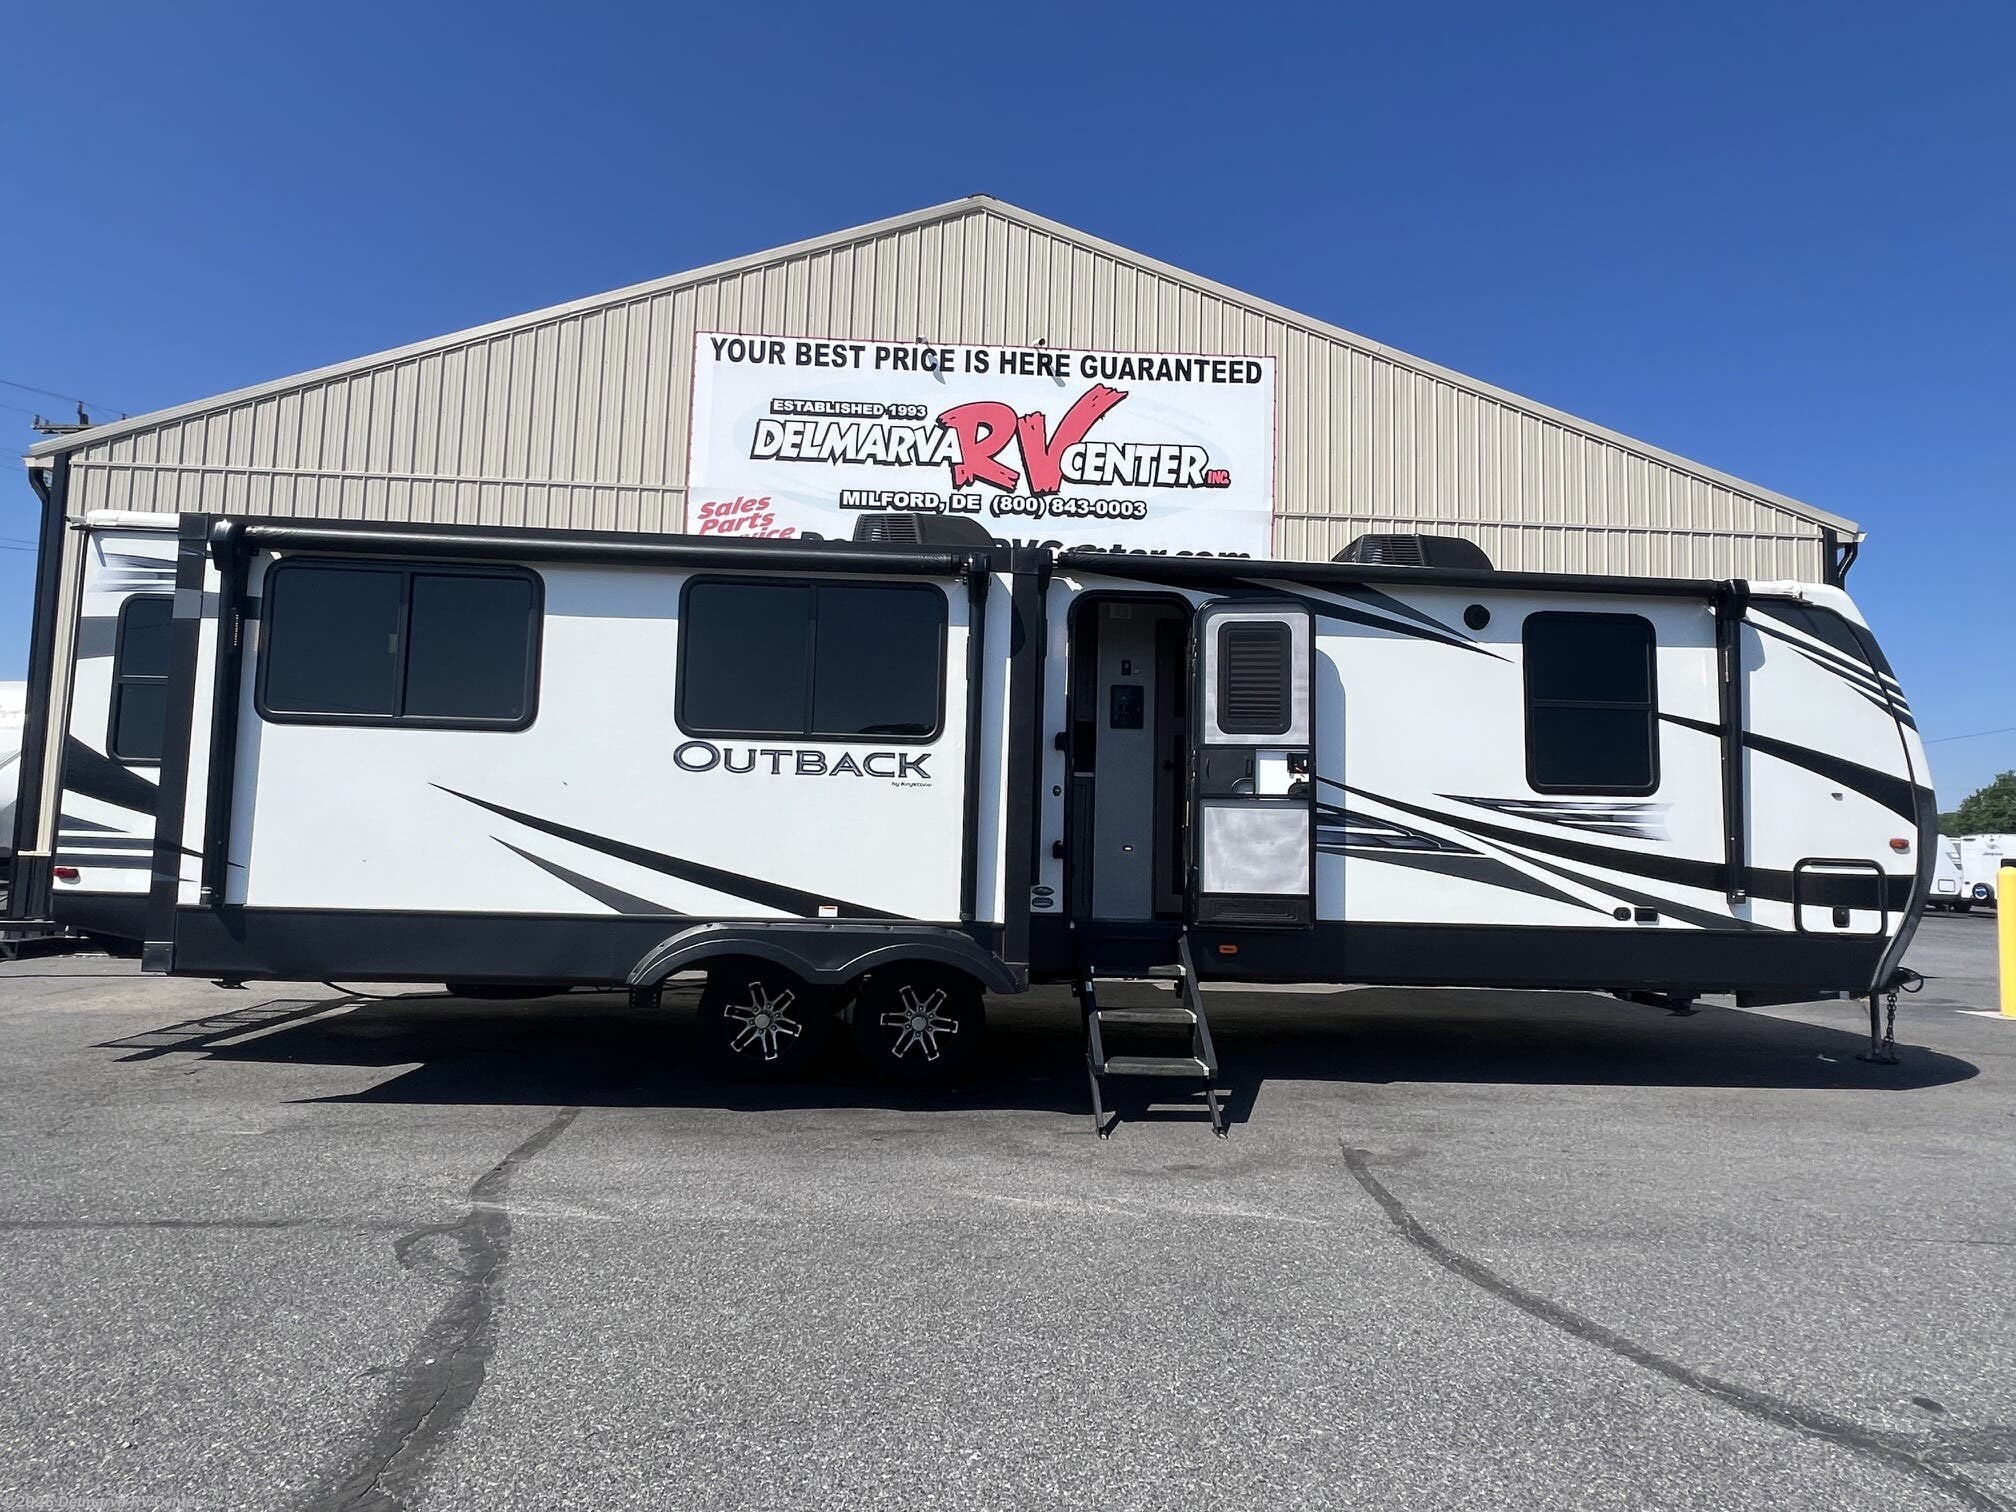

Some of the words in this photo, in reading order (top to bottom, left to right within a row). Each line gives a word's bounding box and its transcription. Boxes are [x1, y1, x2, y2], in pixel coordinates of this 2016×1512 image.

[711, 337, 786, 365] YOUR
[795, 342, 866, 369] BEST
[875, 346, 955, 373] PRICE
[965, 349, 989, 374] IS
[1000, 351, 1071, 378] HERE
[1080, 355, 1262, 384] GUARANTEED
[771, 399, 886, 418] ESTABLISHED
[887, 404, 928, 421] 1993
[751, 419, 964, 465] DELMARVA
[935, 383, 1128, 495] RV
[1059, 442, 1209, 487] CENTER
[697, 496, 772, 519] Sales
[840, 490, 948, 514] MILFORD,
[949, 493, 982, 513] DE
[991, 494, 1047, 519] (800)
[1050, 498, 1148, 520] 843-0003
[699, 513, 776, 536] Parts
